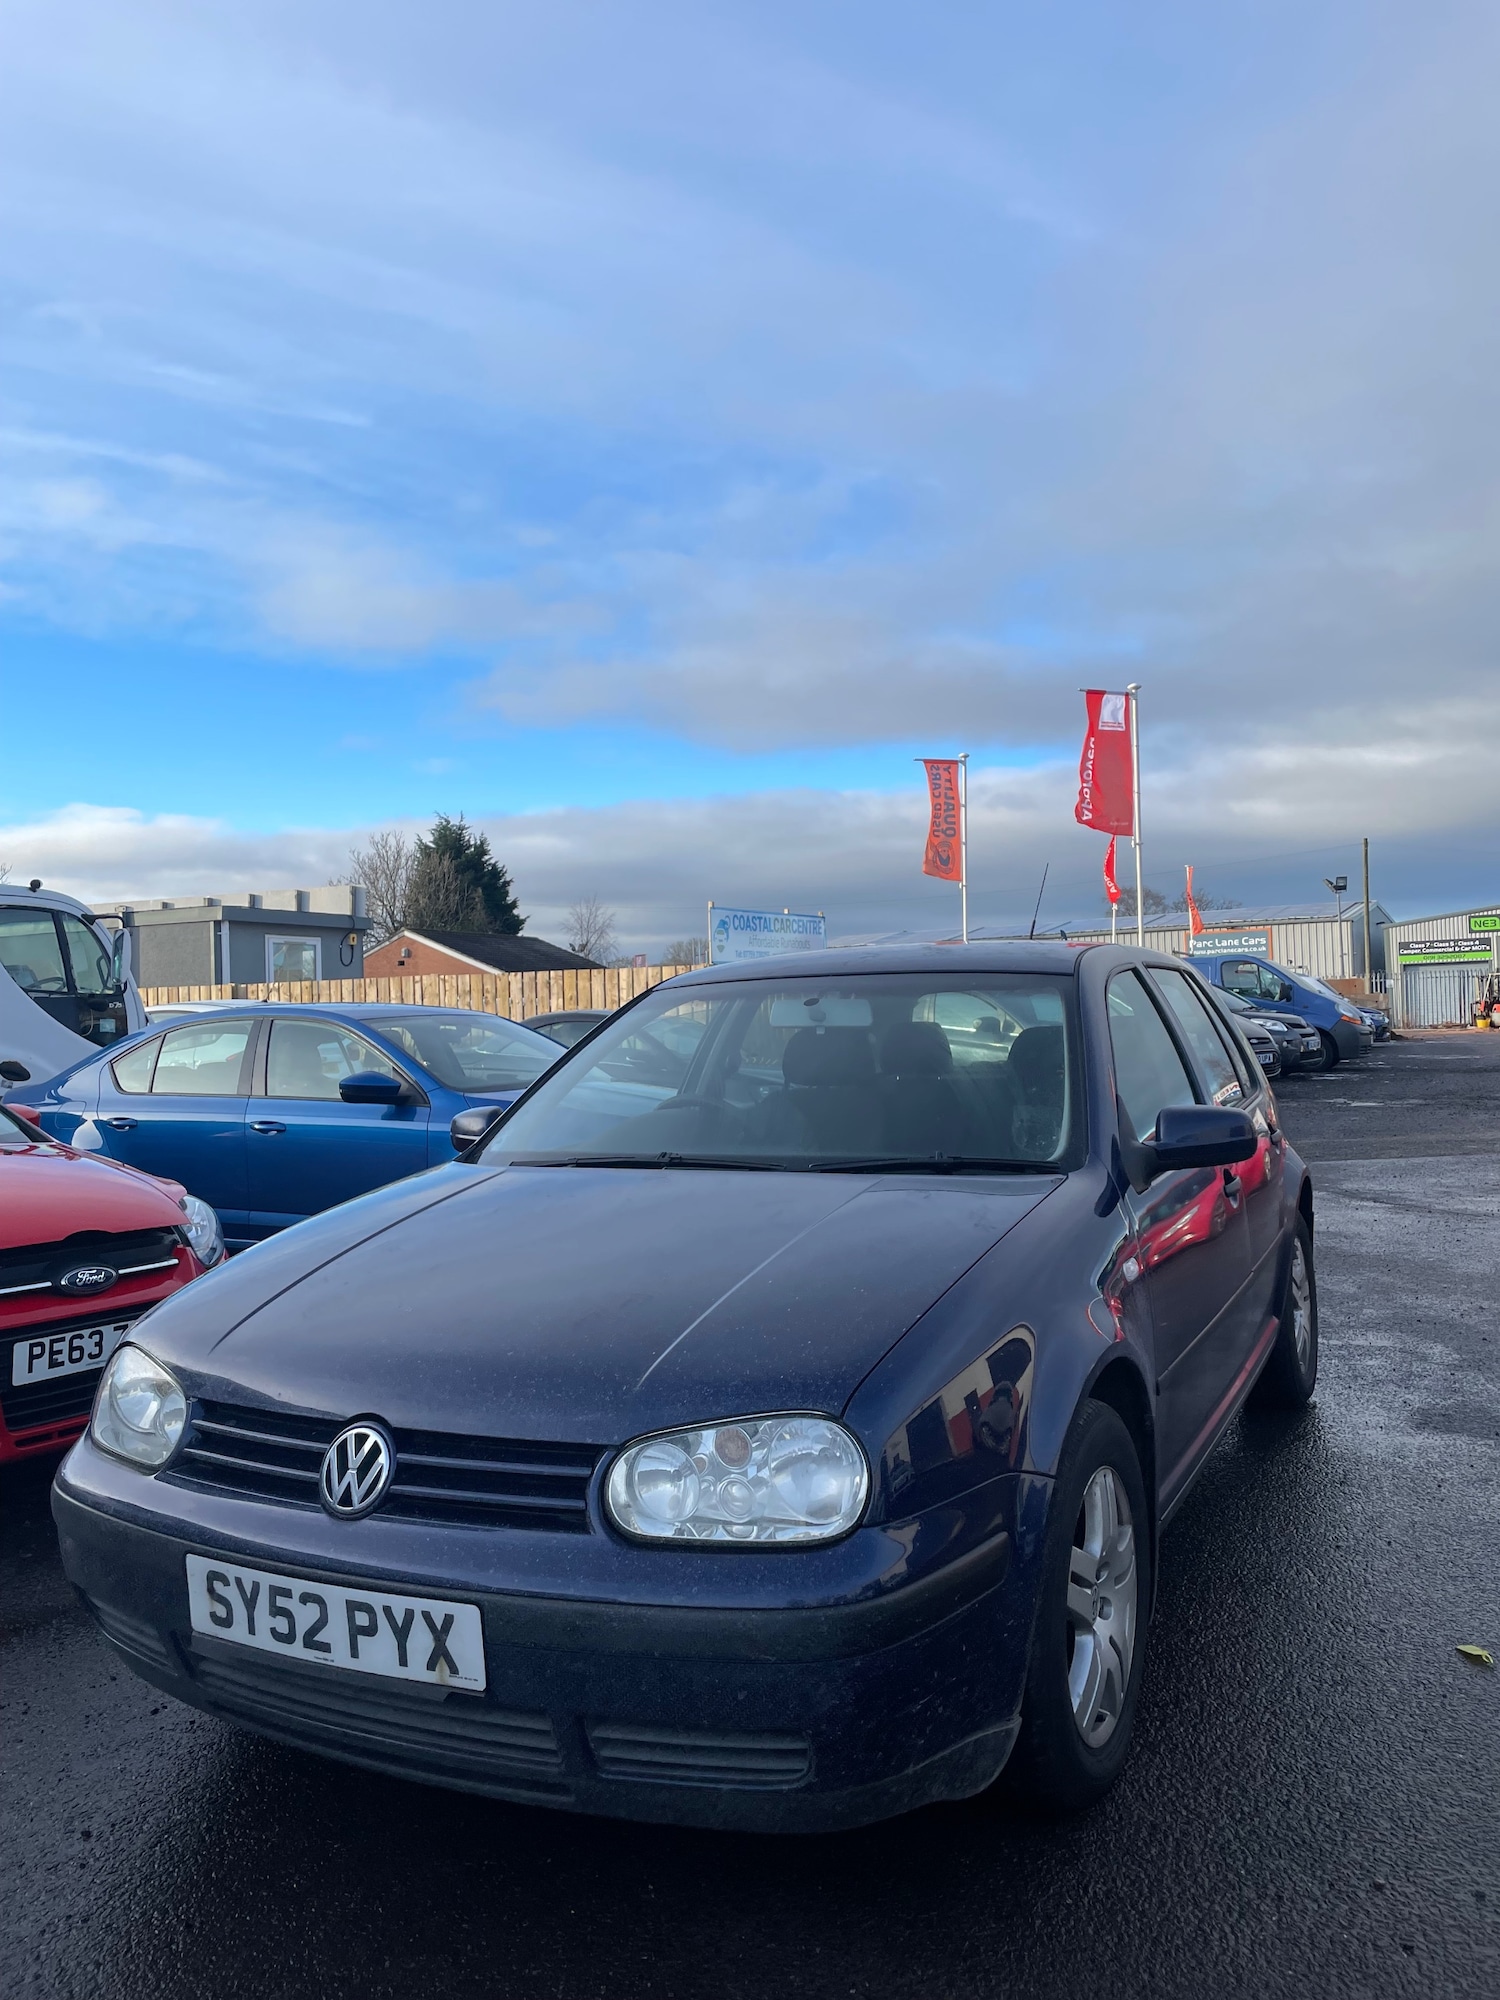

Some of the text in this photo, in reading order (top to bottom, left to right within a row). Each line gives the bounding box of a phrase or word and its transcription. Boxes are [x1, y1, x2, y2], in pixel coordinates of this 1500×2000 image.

[748, 934, 811, 949] Affordable Runabouts
[1189, 937, 1266, 948] Parc Lane Cars
[76, 1269, 106, 1286] Ford
[28, 1330, 103, 1374] PE63
[206, 1570, 459, 1675] SY52 PYX
